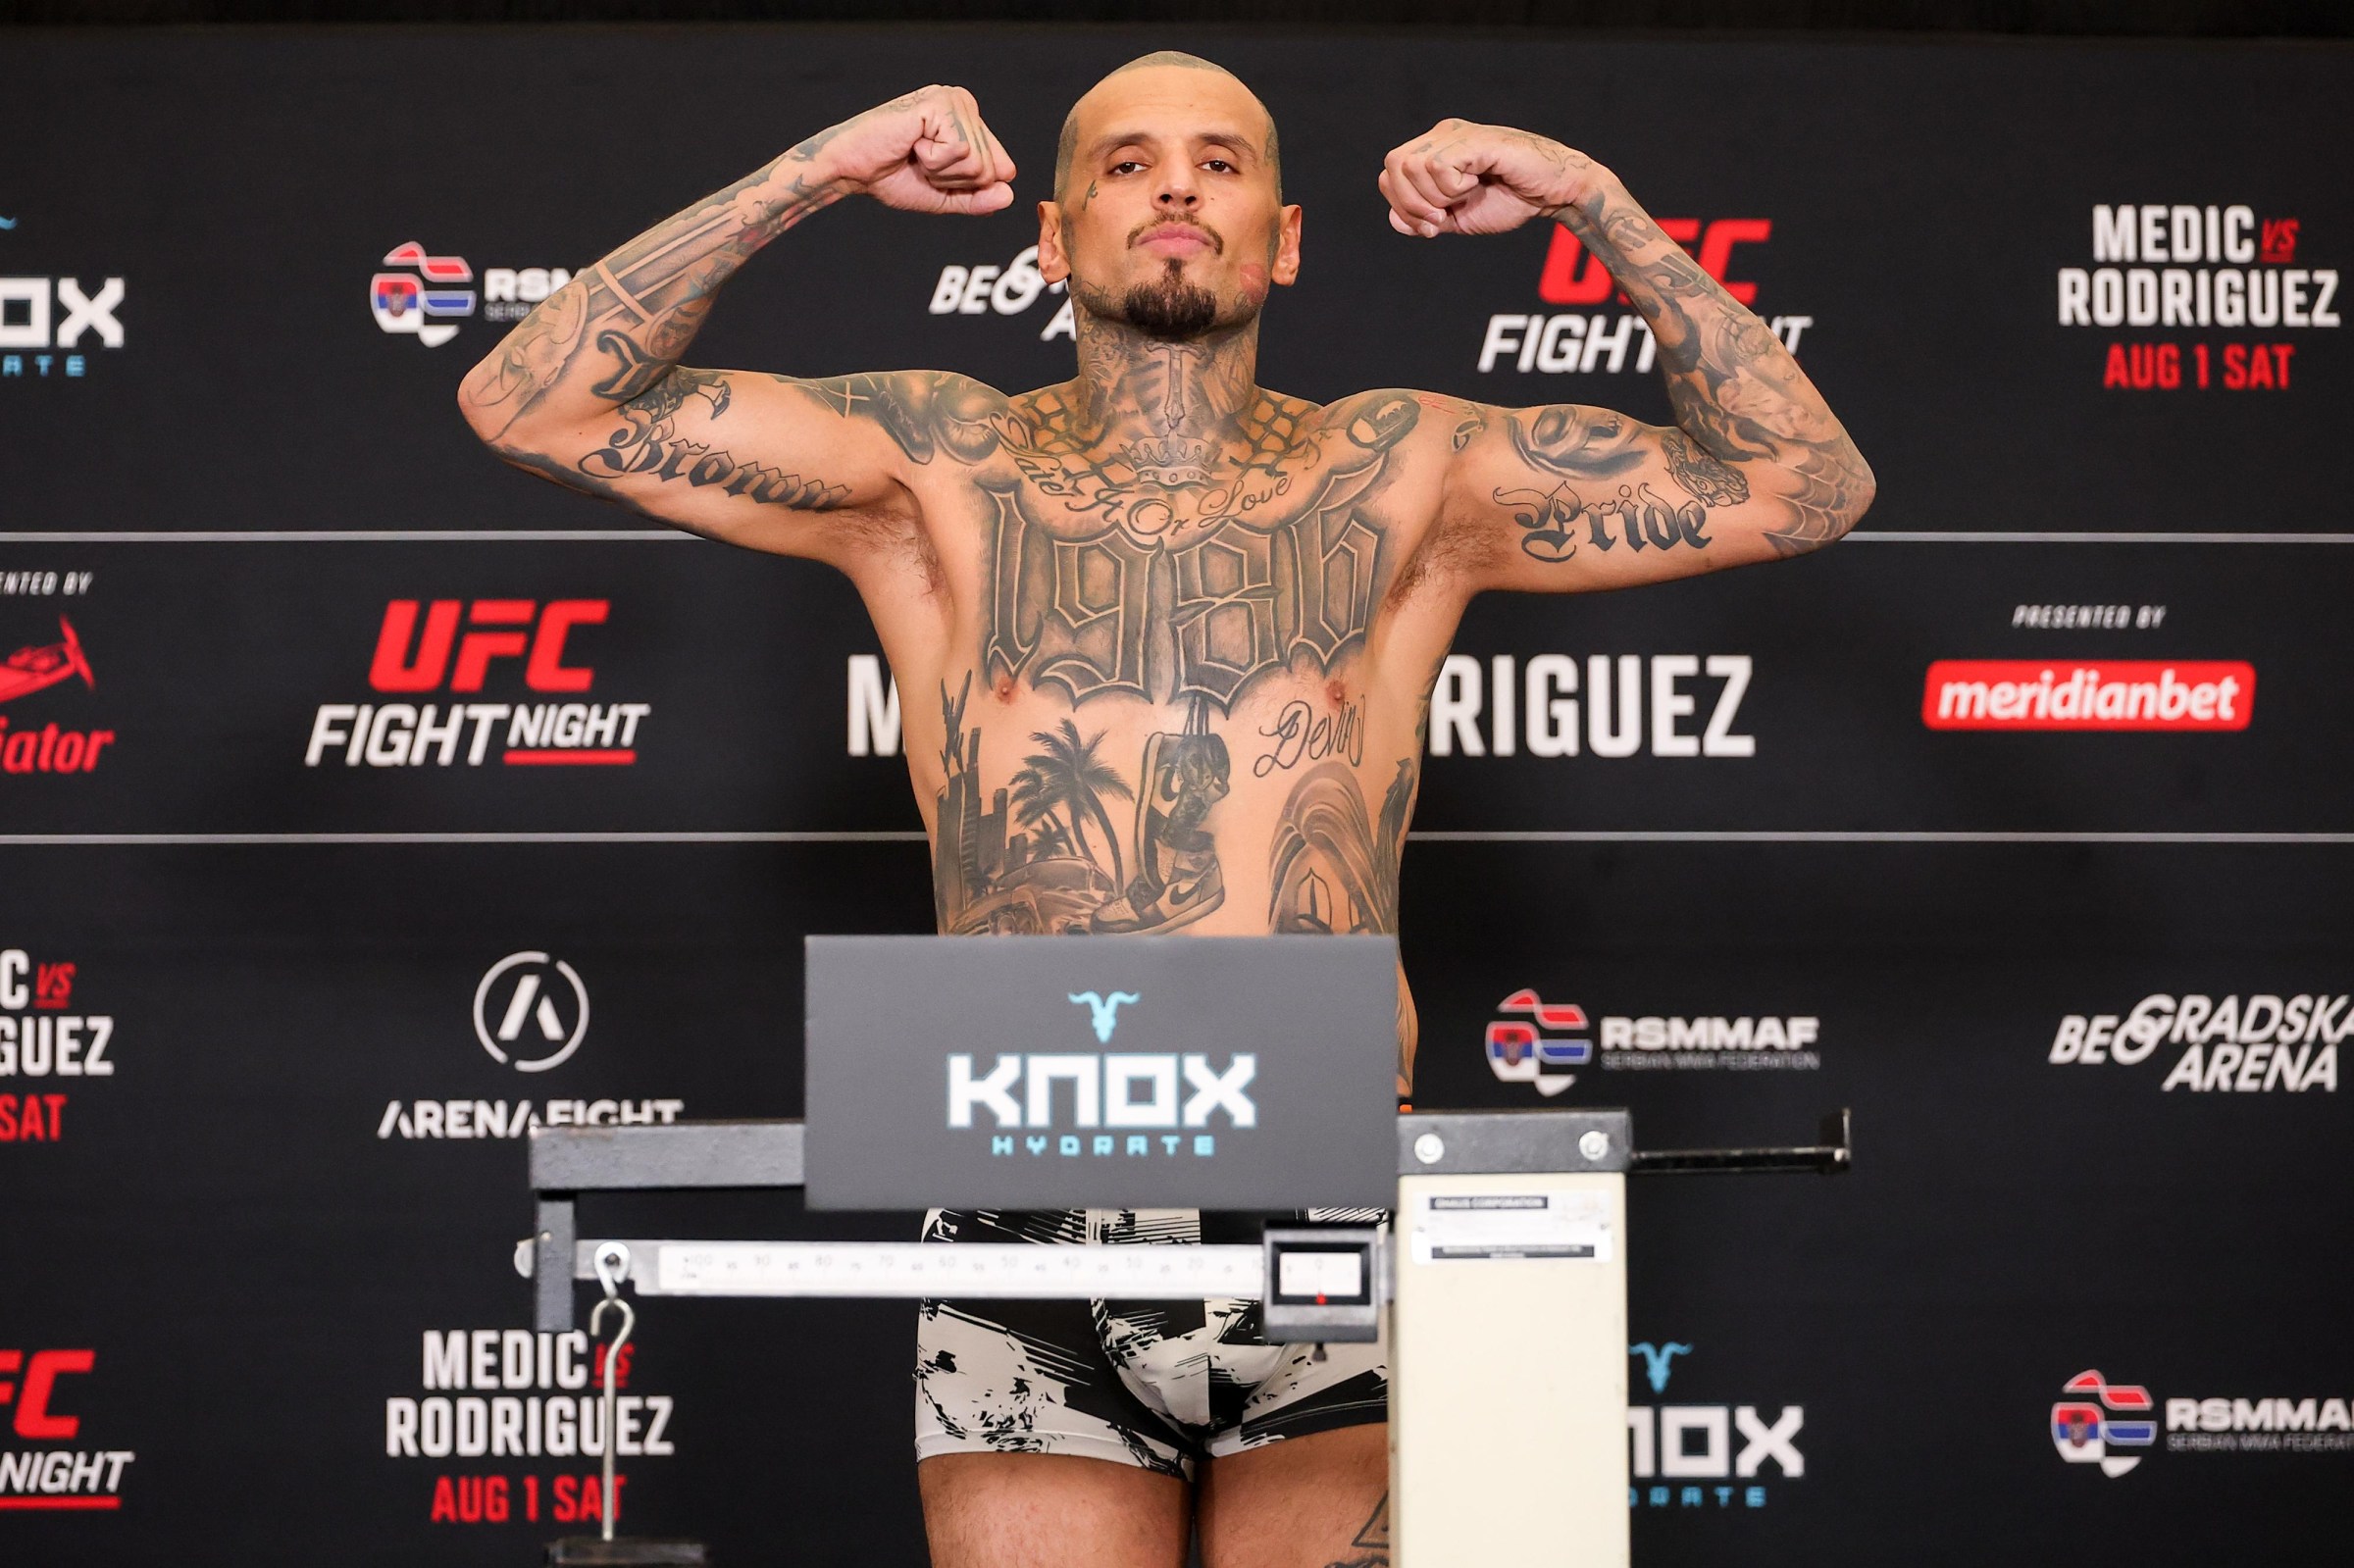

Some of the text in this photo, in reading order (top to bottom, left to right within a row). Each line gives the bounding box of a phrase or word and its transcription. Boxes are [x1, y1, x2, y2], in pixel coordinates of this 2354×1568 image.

[2092, 204, 2256, 264] MEDIC
[2058, 268, 2341, 328] RODRIGUEZ
[1476, 314, 1657, 374] FIGHT
[2103, 342, 2296, 390] AUG 1 SAT
[1198, 479, 1296, 529] Love
[1492, 480, 1713, 563] Pride
[2012, 604, 2166, 629] PRESENTED BY
[368, 598, 610, 693] UFC
[1937, 668, 2240, 721] meridianbet
[304, 703, 651, 767] FIGHT NIGHT
[1600, 1016, 1819, 1050] RSMMAF
[946, 1052, 1258, 1130] KNOX
[2161, 1042, 2337, 1092] ARENA
[992, 1135, 1215, 1157] HYDRATE
[422, 1329, 588, 1391] MEDIC
[386, 1394, 675, 1457] RODRIGUEZ
[2166, 1397, 2354, 1432] RSMMA
[0, 1450, 135, 1494] NIGHT
[431, 1475, 510, 1522] AUG
[523, 1475, 539, 1521] 1
